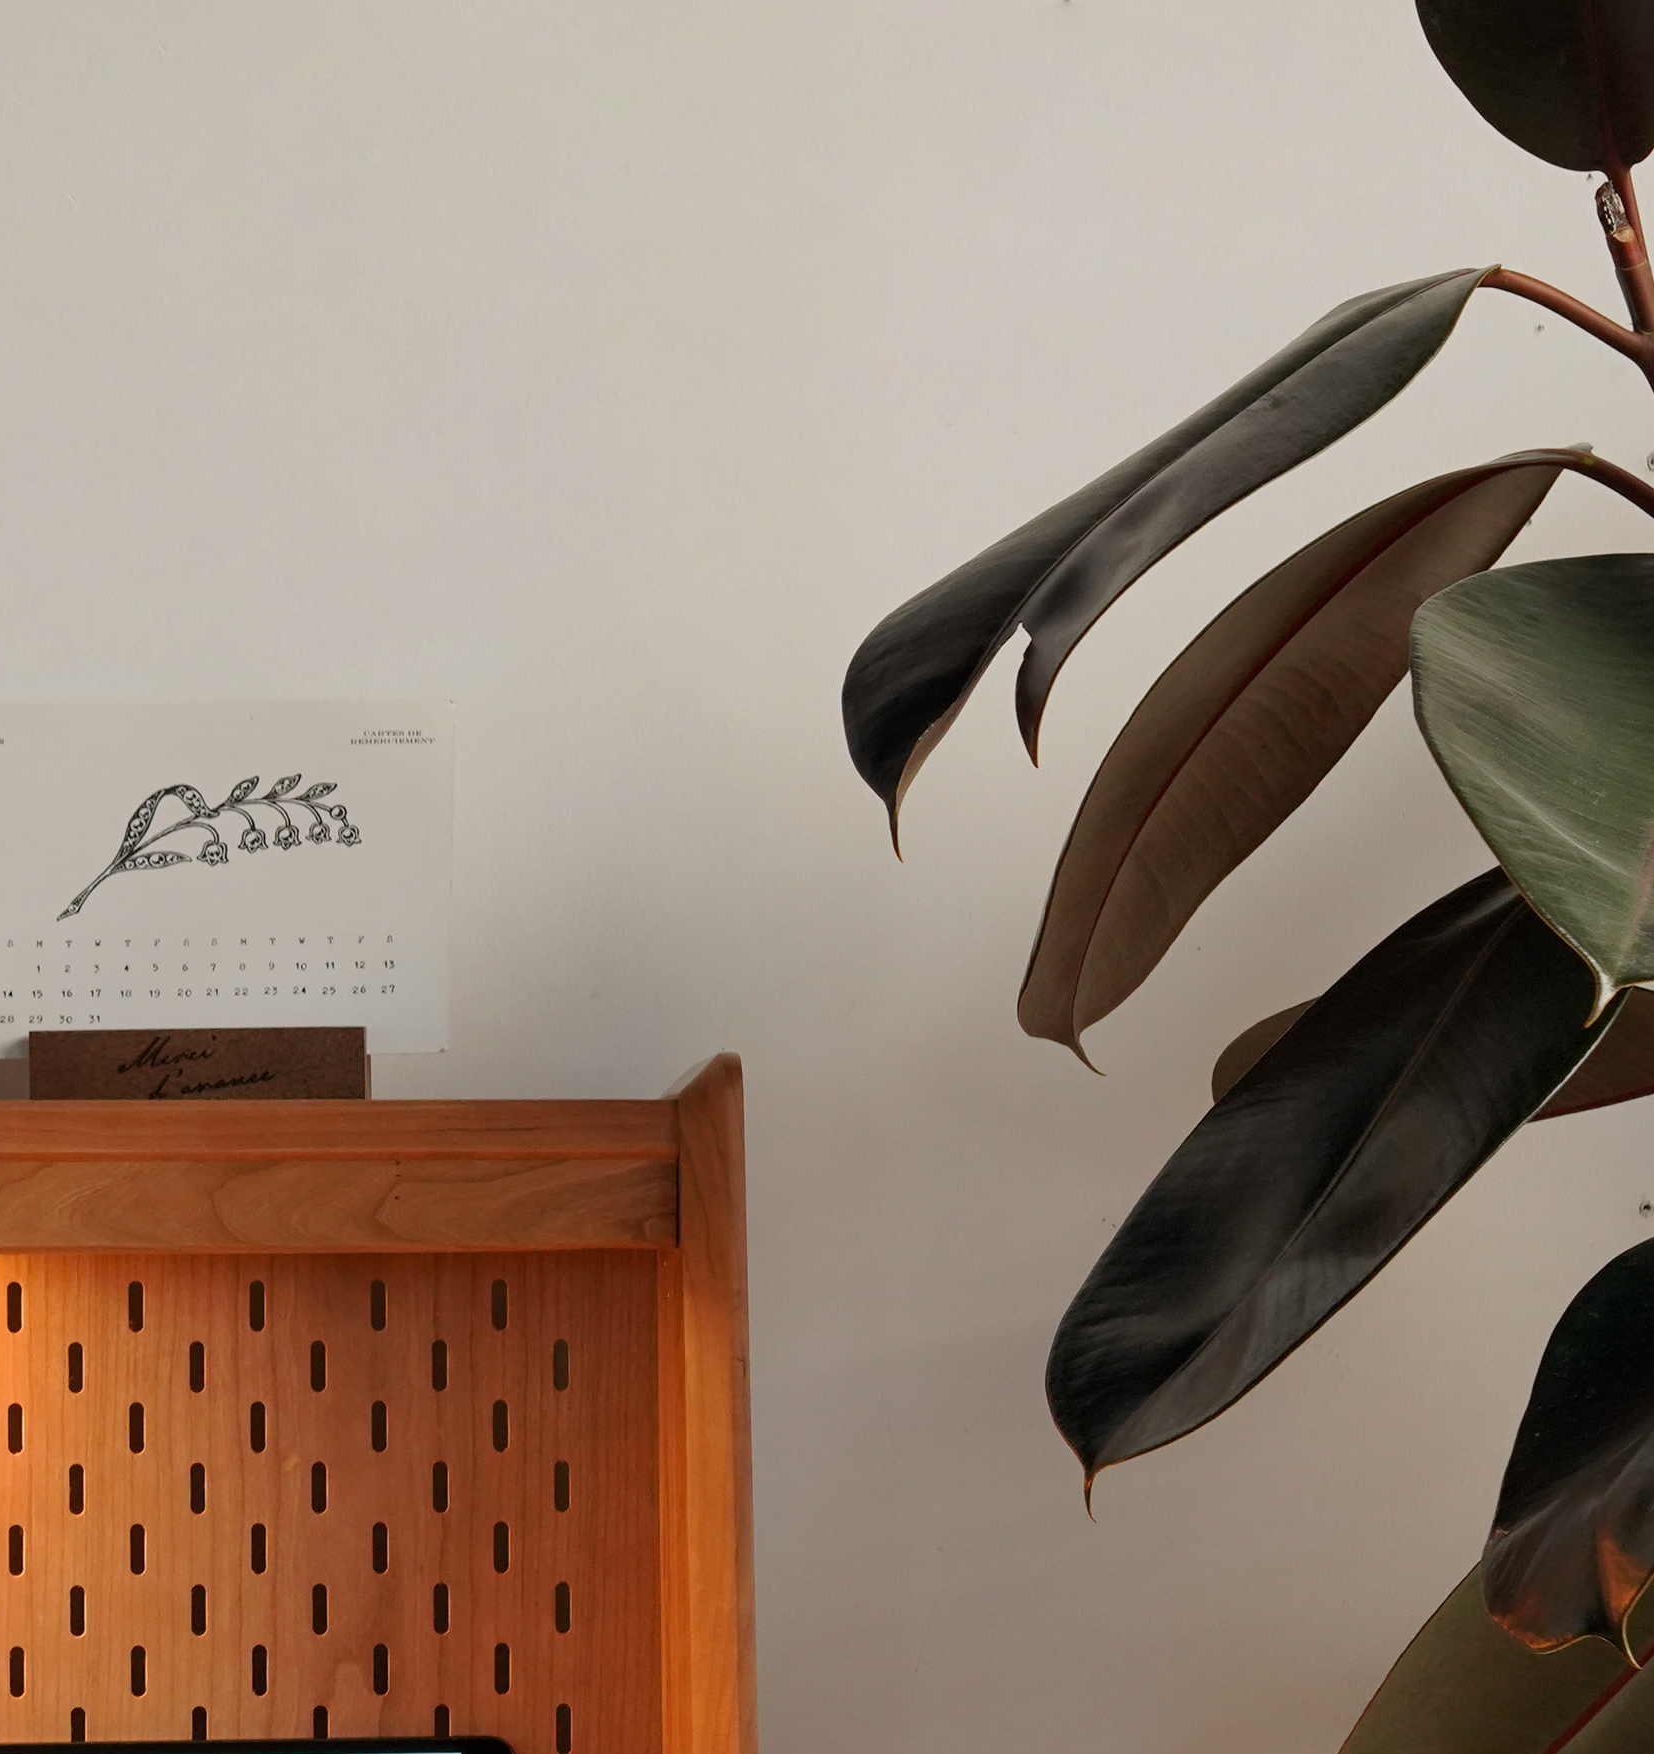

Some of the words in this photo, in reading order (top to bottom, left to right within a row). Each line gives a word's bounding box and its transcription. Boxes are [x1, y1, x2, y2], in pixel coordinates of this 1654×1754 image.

[296, 962, 307, 971] 10
[326, 962, 335, 970] 11
[355, 961, 366, 969] 12
[384, 960, 395, 969] 13
[3, 990, 13, 998] 14
[32, 990, 43, 998] 15
[62, 990, 72, 998] 16
[90, 989, 101, 998] 17
[121, 989, 132, 997] 18
[149, 989, 160, 997] 19
[177, 989, 192, 997] 20
[234, 988, 249, 996] 22
[264, 987, 278, 995] 23
[293, 987, 307, 995] 24
[322, 987, 336, 995] 25
[352, 986, 366, 994] 26
[381, 985, 395, 994] 27
[59, 1015, 73, 1023] 30
[89, 1015, 101, 1023] 31
[117, 1034, 218, 1074] Merci
